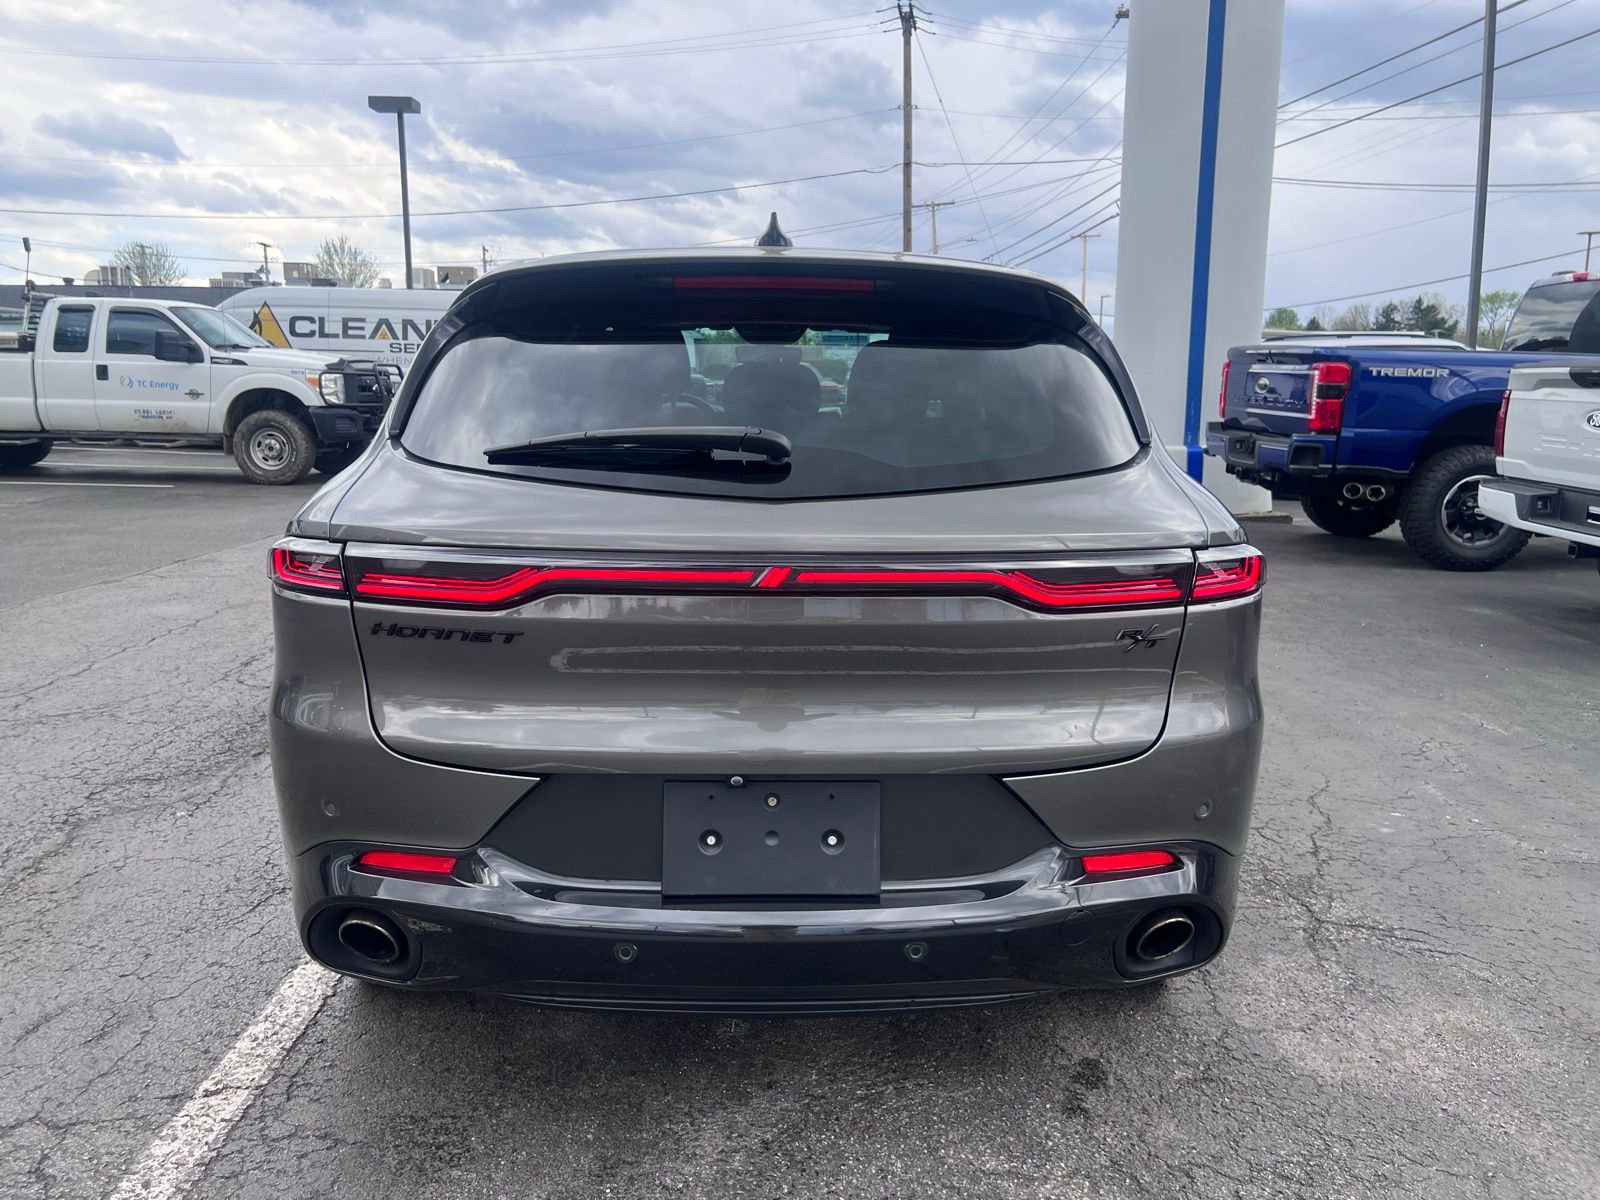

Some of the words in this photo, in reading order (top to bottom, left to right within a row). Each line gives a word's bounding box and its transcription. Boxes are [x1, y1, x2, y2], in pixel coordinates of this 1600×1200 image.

[289, 315, 438, 341] CLEAN
[1368, 366, 1450, 378] TREMOR
[136, 380, 148, 388] TC
[149, 381, 180, 391] Energy
[370, 621, 525, 645] HORNET
[1115, 623, 1168, 653] R/T
